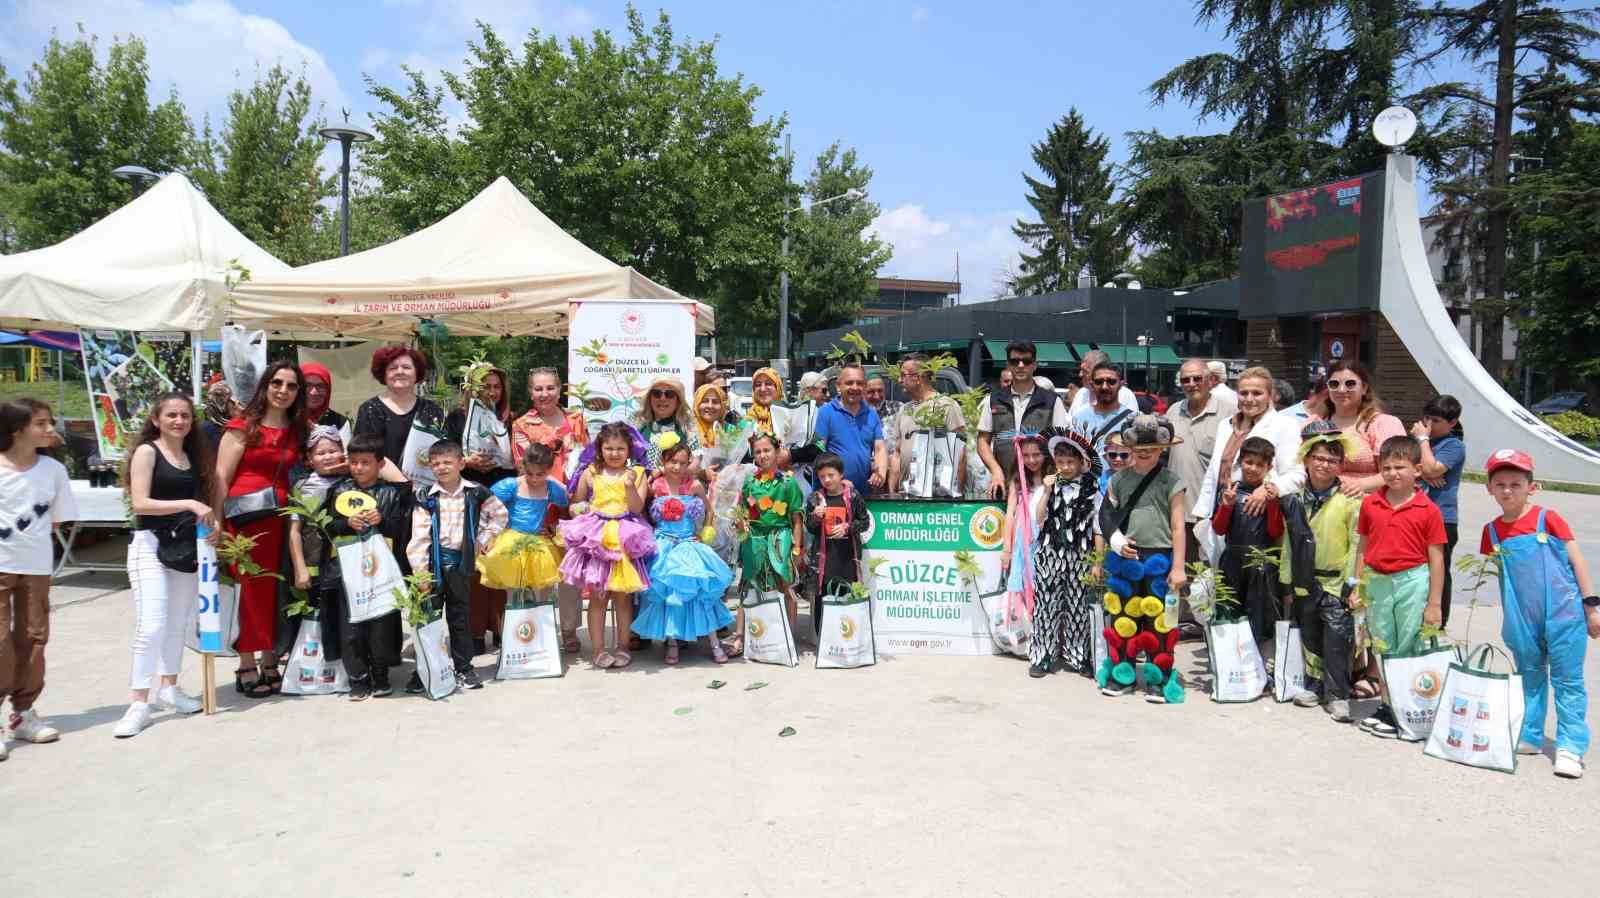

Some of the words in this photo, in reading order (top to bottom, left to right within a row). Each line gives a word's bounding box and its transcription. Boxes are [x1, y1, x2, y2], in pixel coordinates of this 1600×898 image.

[363, 303, 389, 313] TARIM
[391, 303, 402, 312] VE
[404, 302, 434, 313] ORMAN
[880, 511, 923, 524] ORMAN
[926, 513, 964, 526] GENEL
[884, 526, 960, 542] MÜDÜRLÜĞÜ
[889, 560, 959, 586] DÜZCE
[876, 590, 918, 602] ORMAN
[922, 589, 972, 606] İŞLETME
[886, 604, 960, 619] MÜDÜRLÜĞÜ
